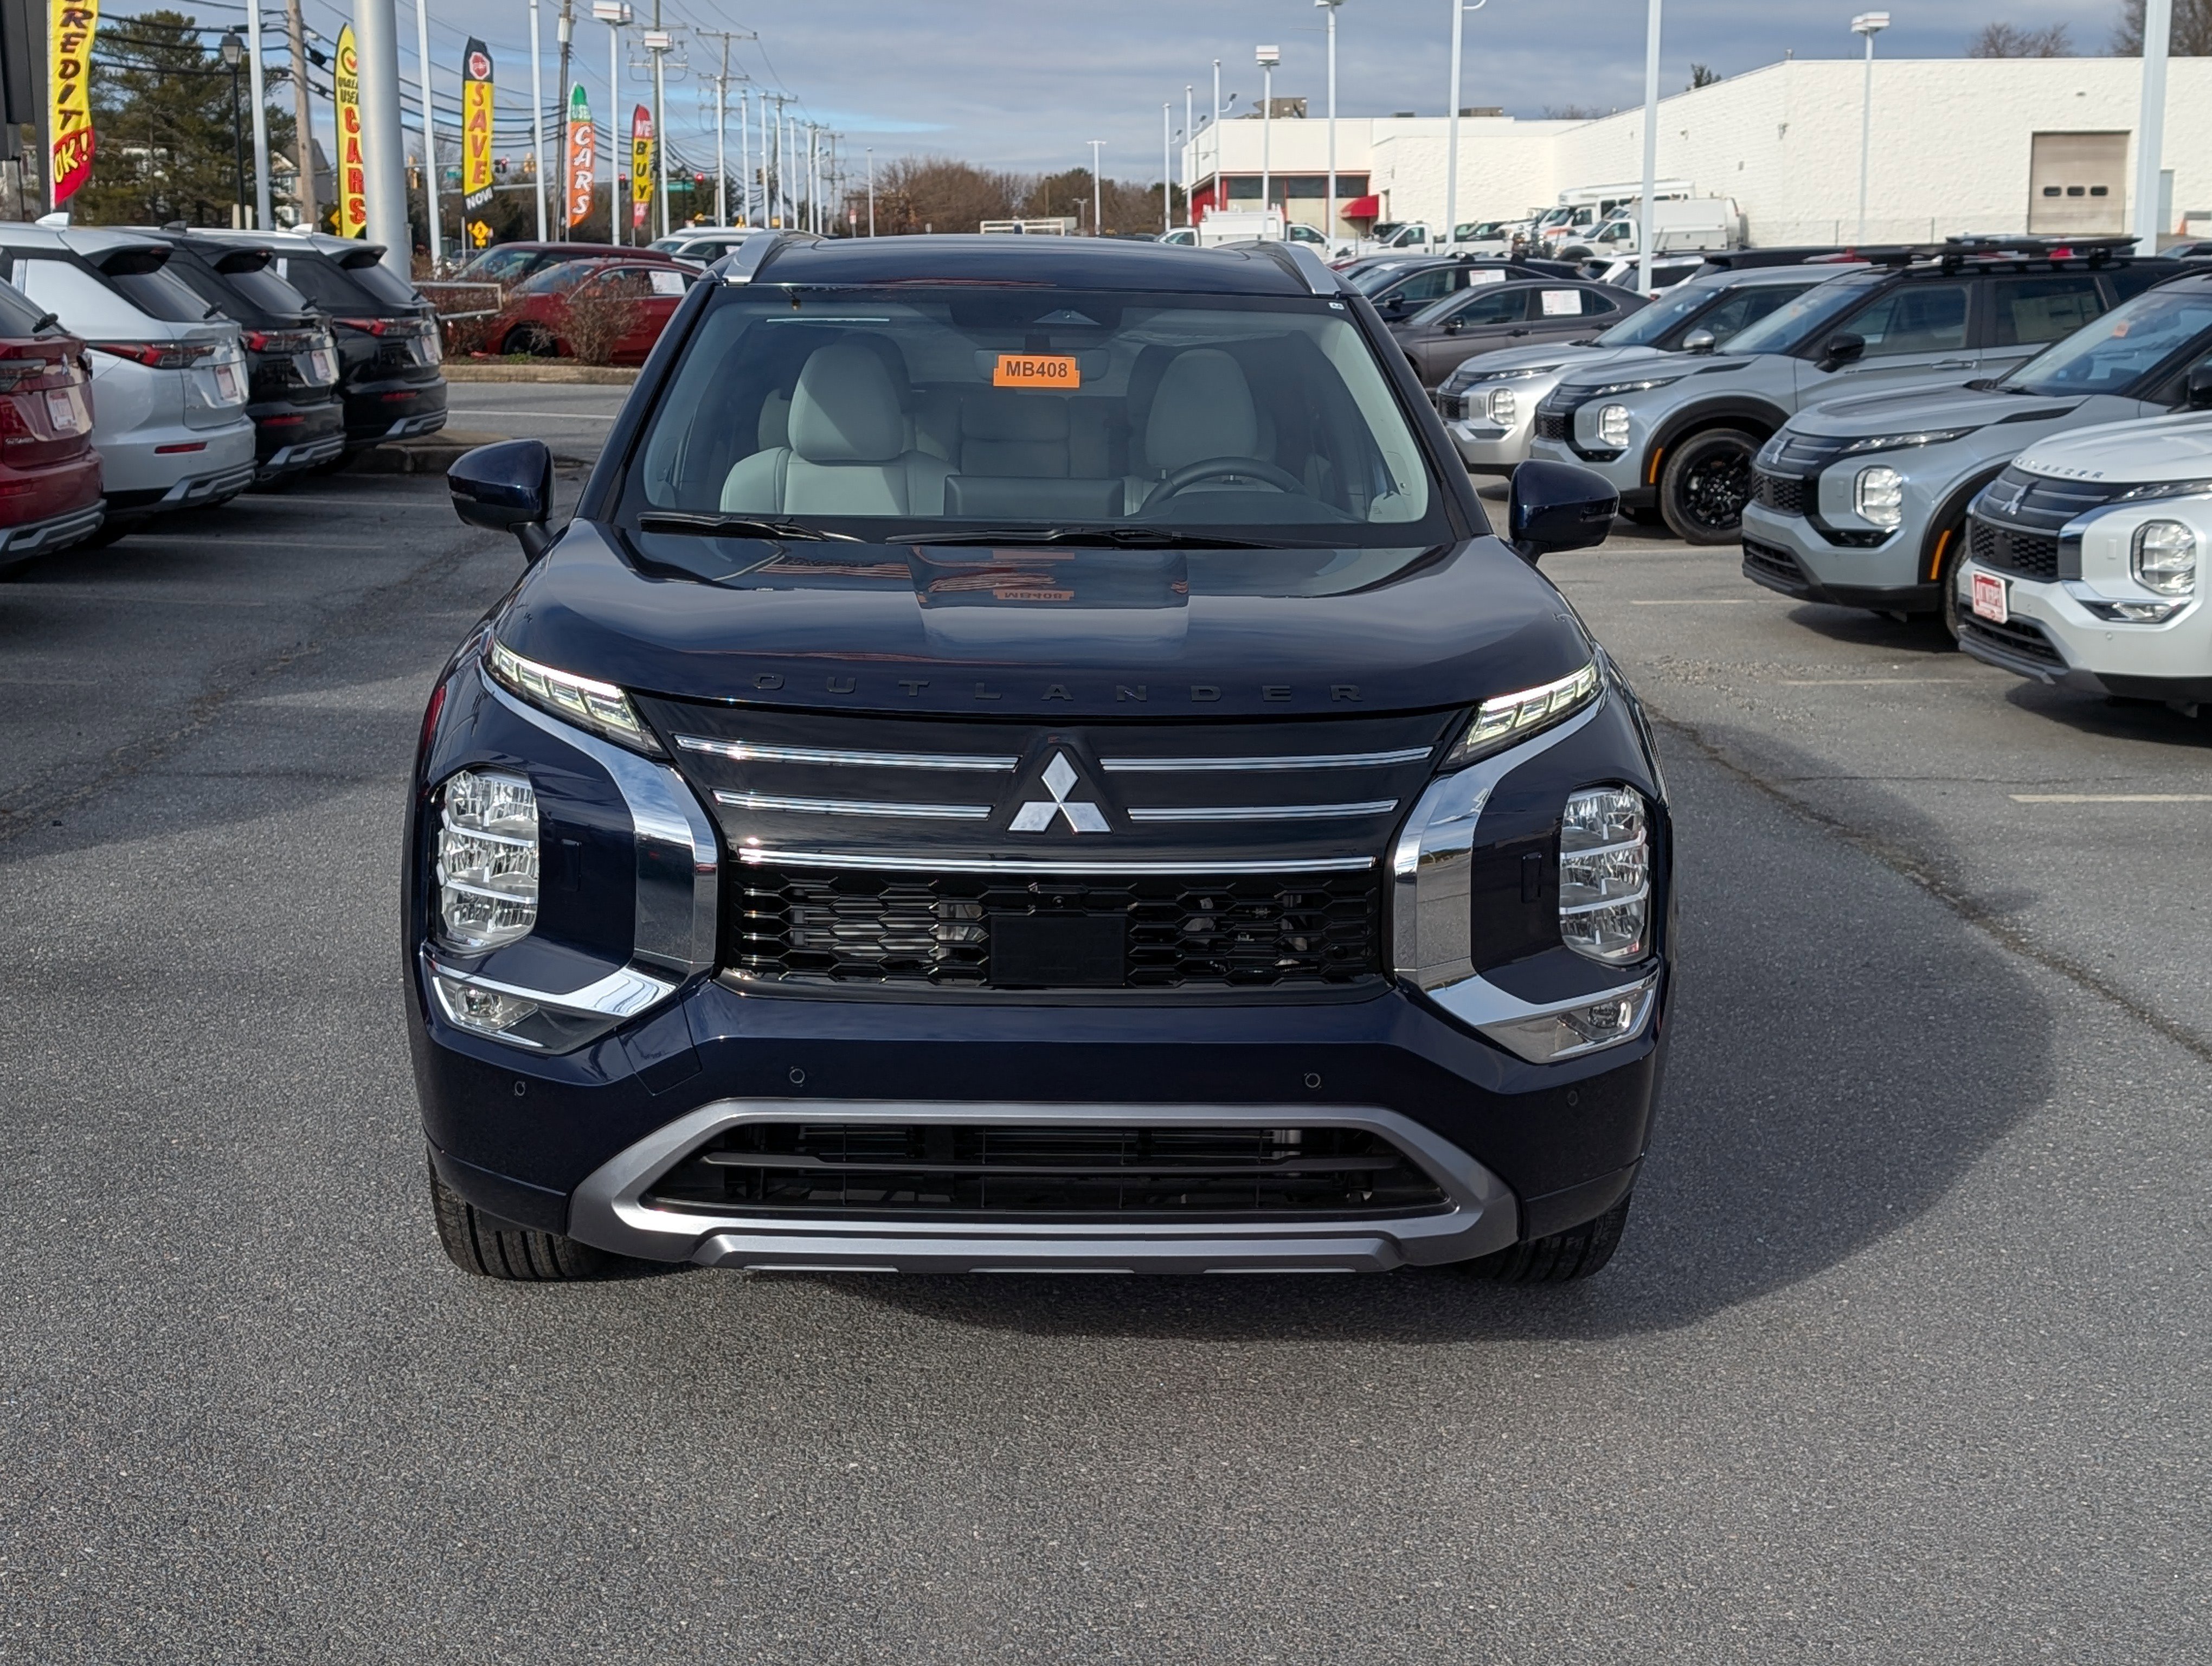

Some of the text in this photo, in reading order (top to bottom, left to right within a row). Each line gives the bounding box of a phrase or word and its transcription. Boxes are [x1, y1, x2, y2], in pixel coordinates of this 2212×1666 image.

[57, 0, 94, 131] REDIT
[54, 132, 88, 183] OK!
[468, 82, 488, 184] SAVE
[344, 106, 366, 225] CARS
[573, 125, 593, 214] CARS
[636, 141, 647, 199] BUY
[465, 187, 493, 211] NOW
[1006, 360, 1068, 378] MB408
[753, 672, 1364, 702] OUTLANDER
